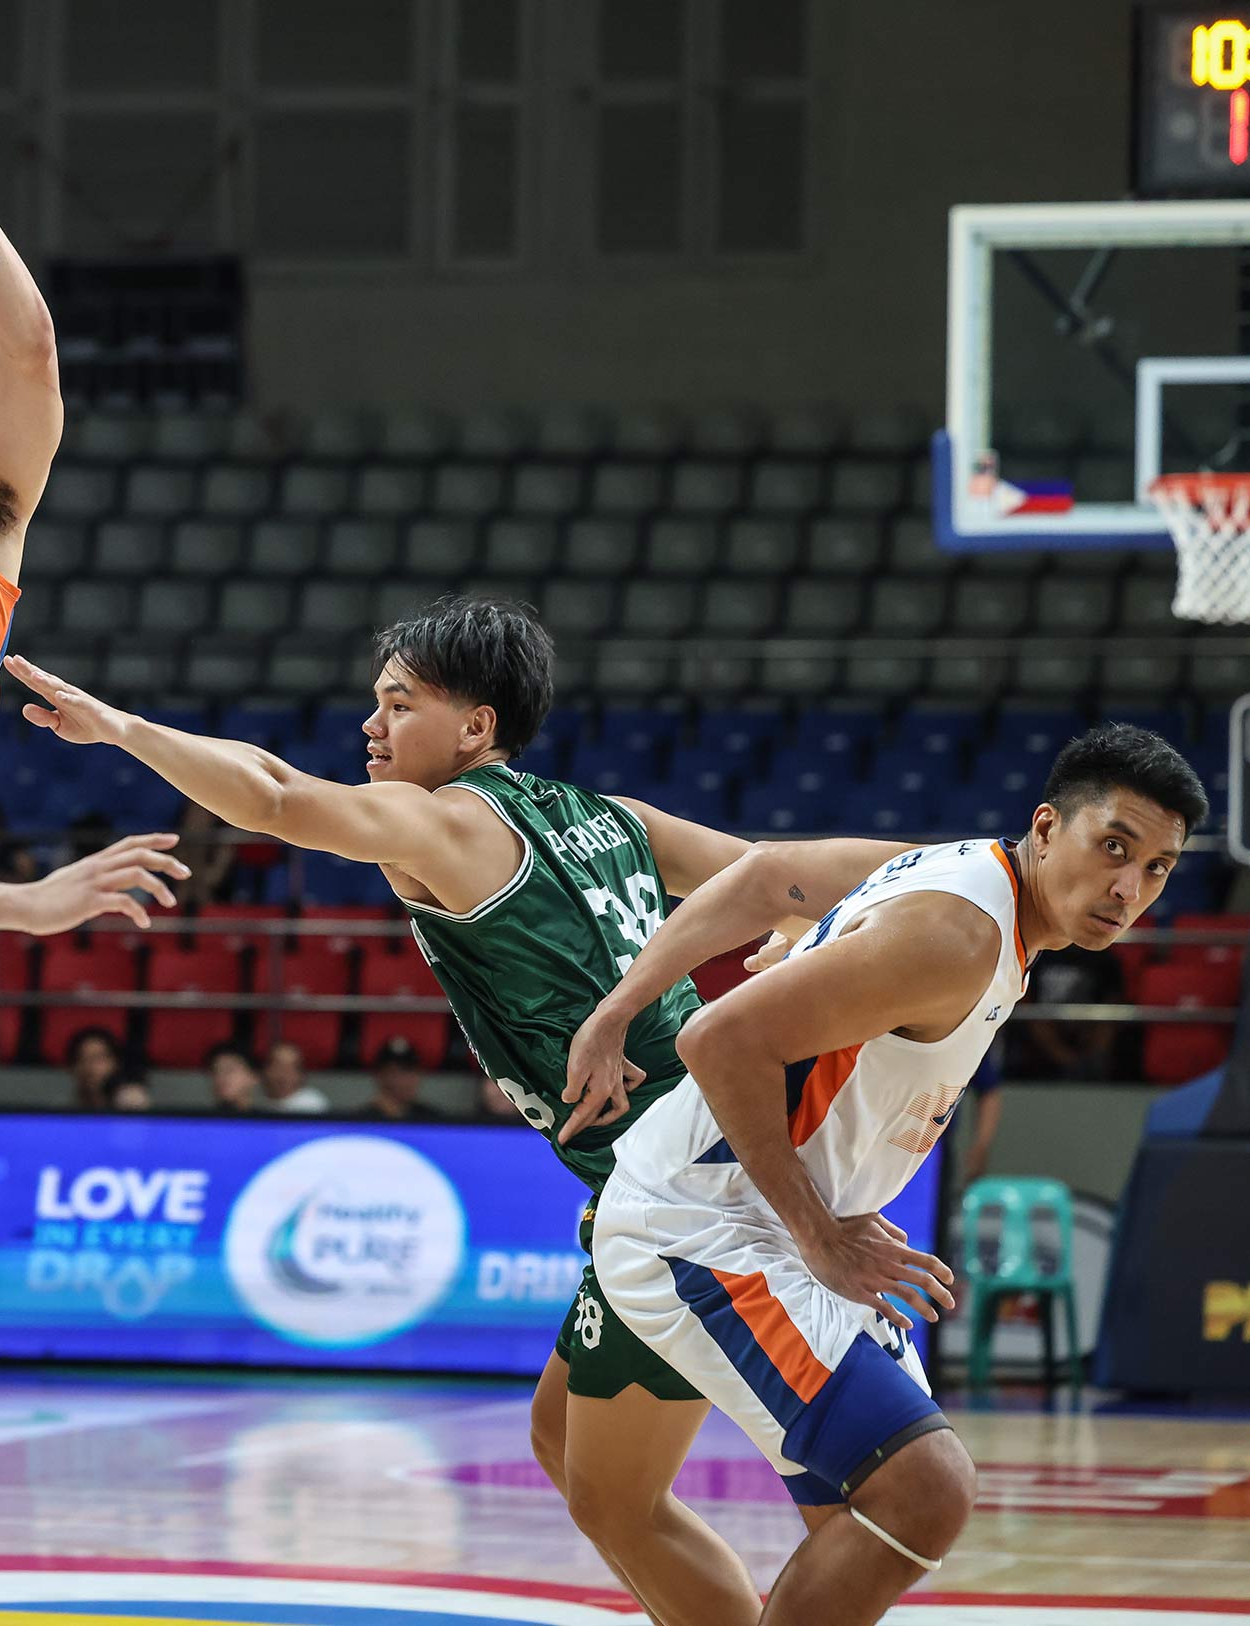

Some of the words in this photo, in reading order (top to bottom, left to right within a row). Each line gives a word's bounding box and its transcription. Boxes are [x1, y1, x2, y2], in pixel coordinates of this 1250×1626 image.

[496, 1077, 556, 1130] 8
[36, 1165, 210, 1224] LOVE
[27, 1249, 198, 1321] DROP
